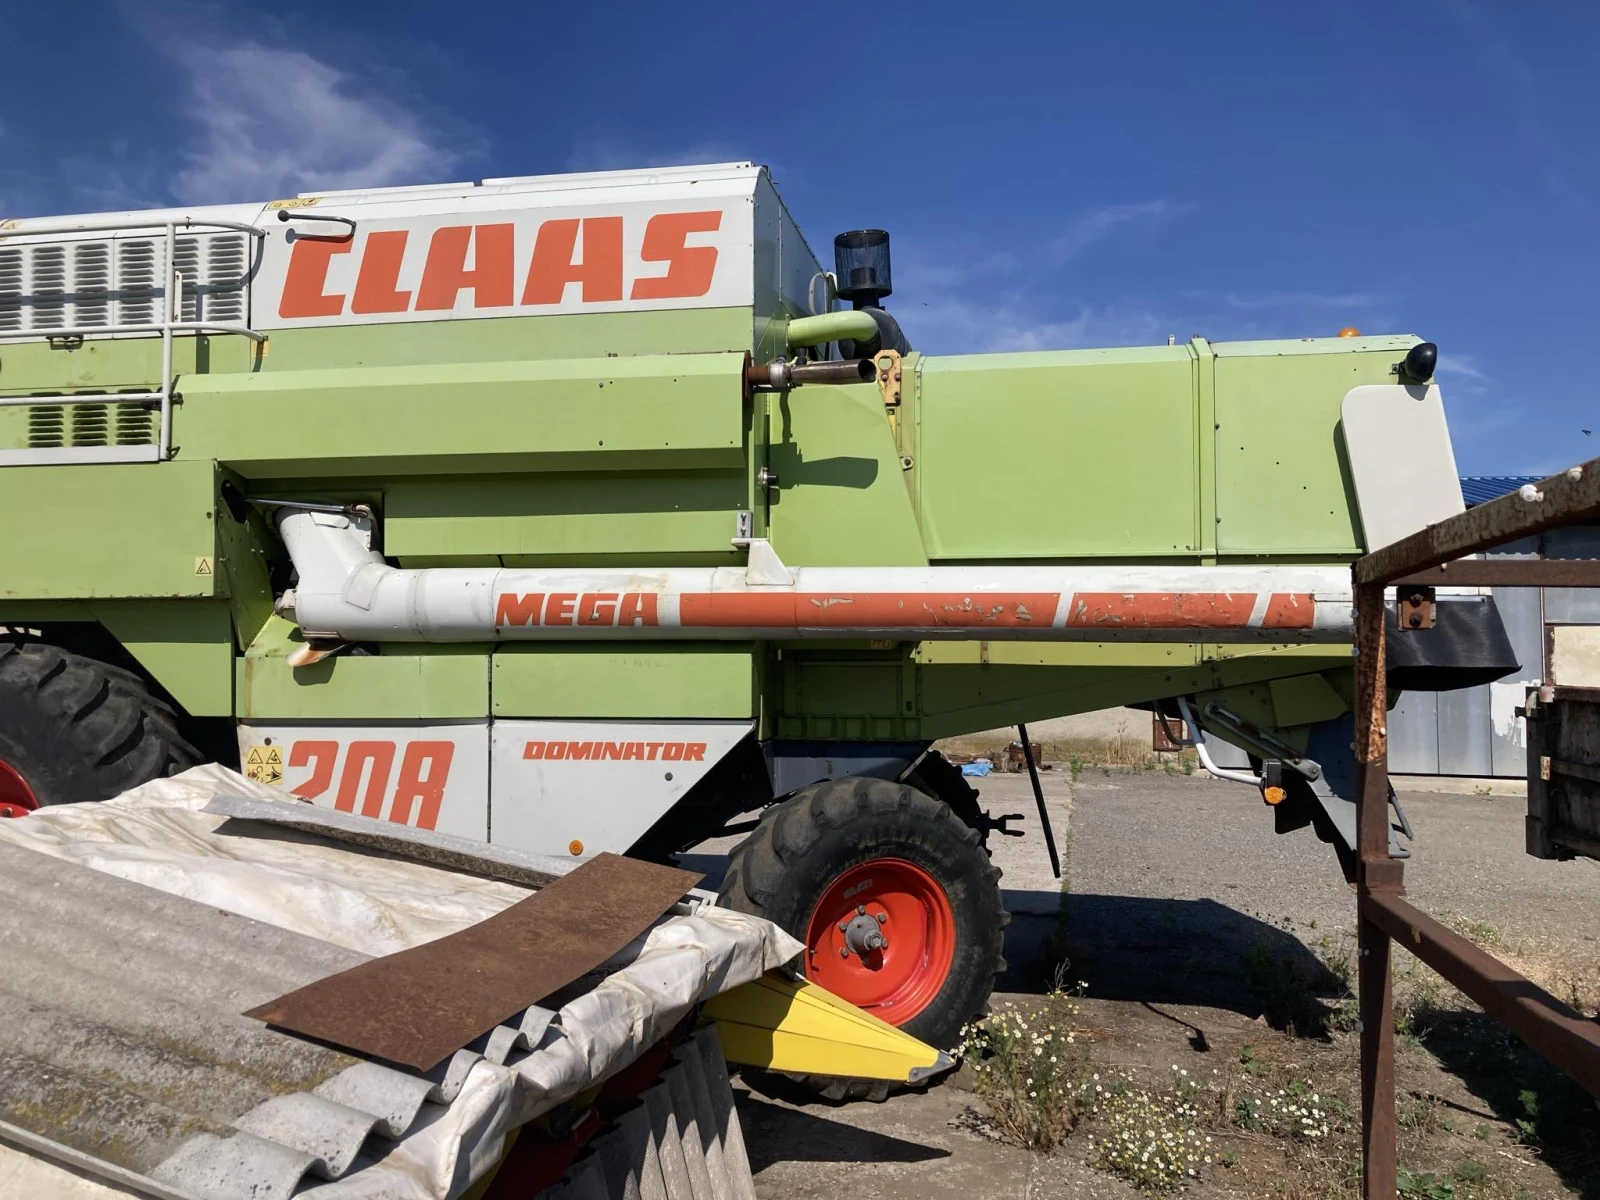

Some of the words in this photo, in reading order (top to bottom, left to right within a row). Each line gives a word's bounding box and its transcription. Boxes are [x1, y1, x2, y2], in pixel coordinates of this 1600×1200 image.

[278, 211, 723, 319] CLAAS
[496, 592, 659, 627] MEGA
[523, 741, 707, 761] DOMINATOR
[288, 740, 455, 831] 208
